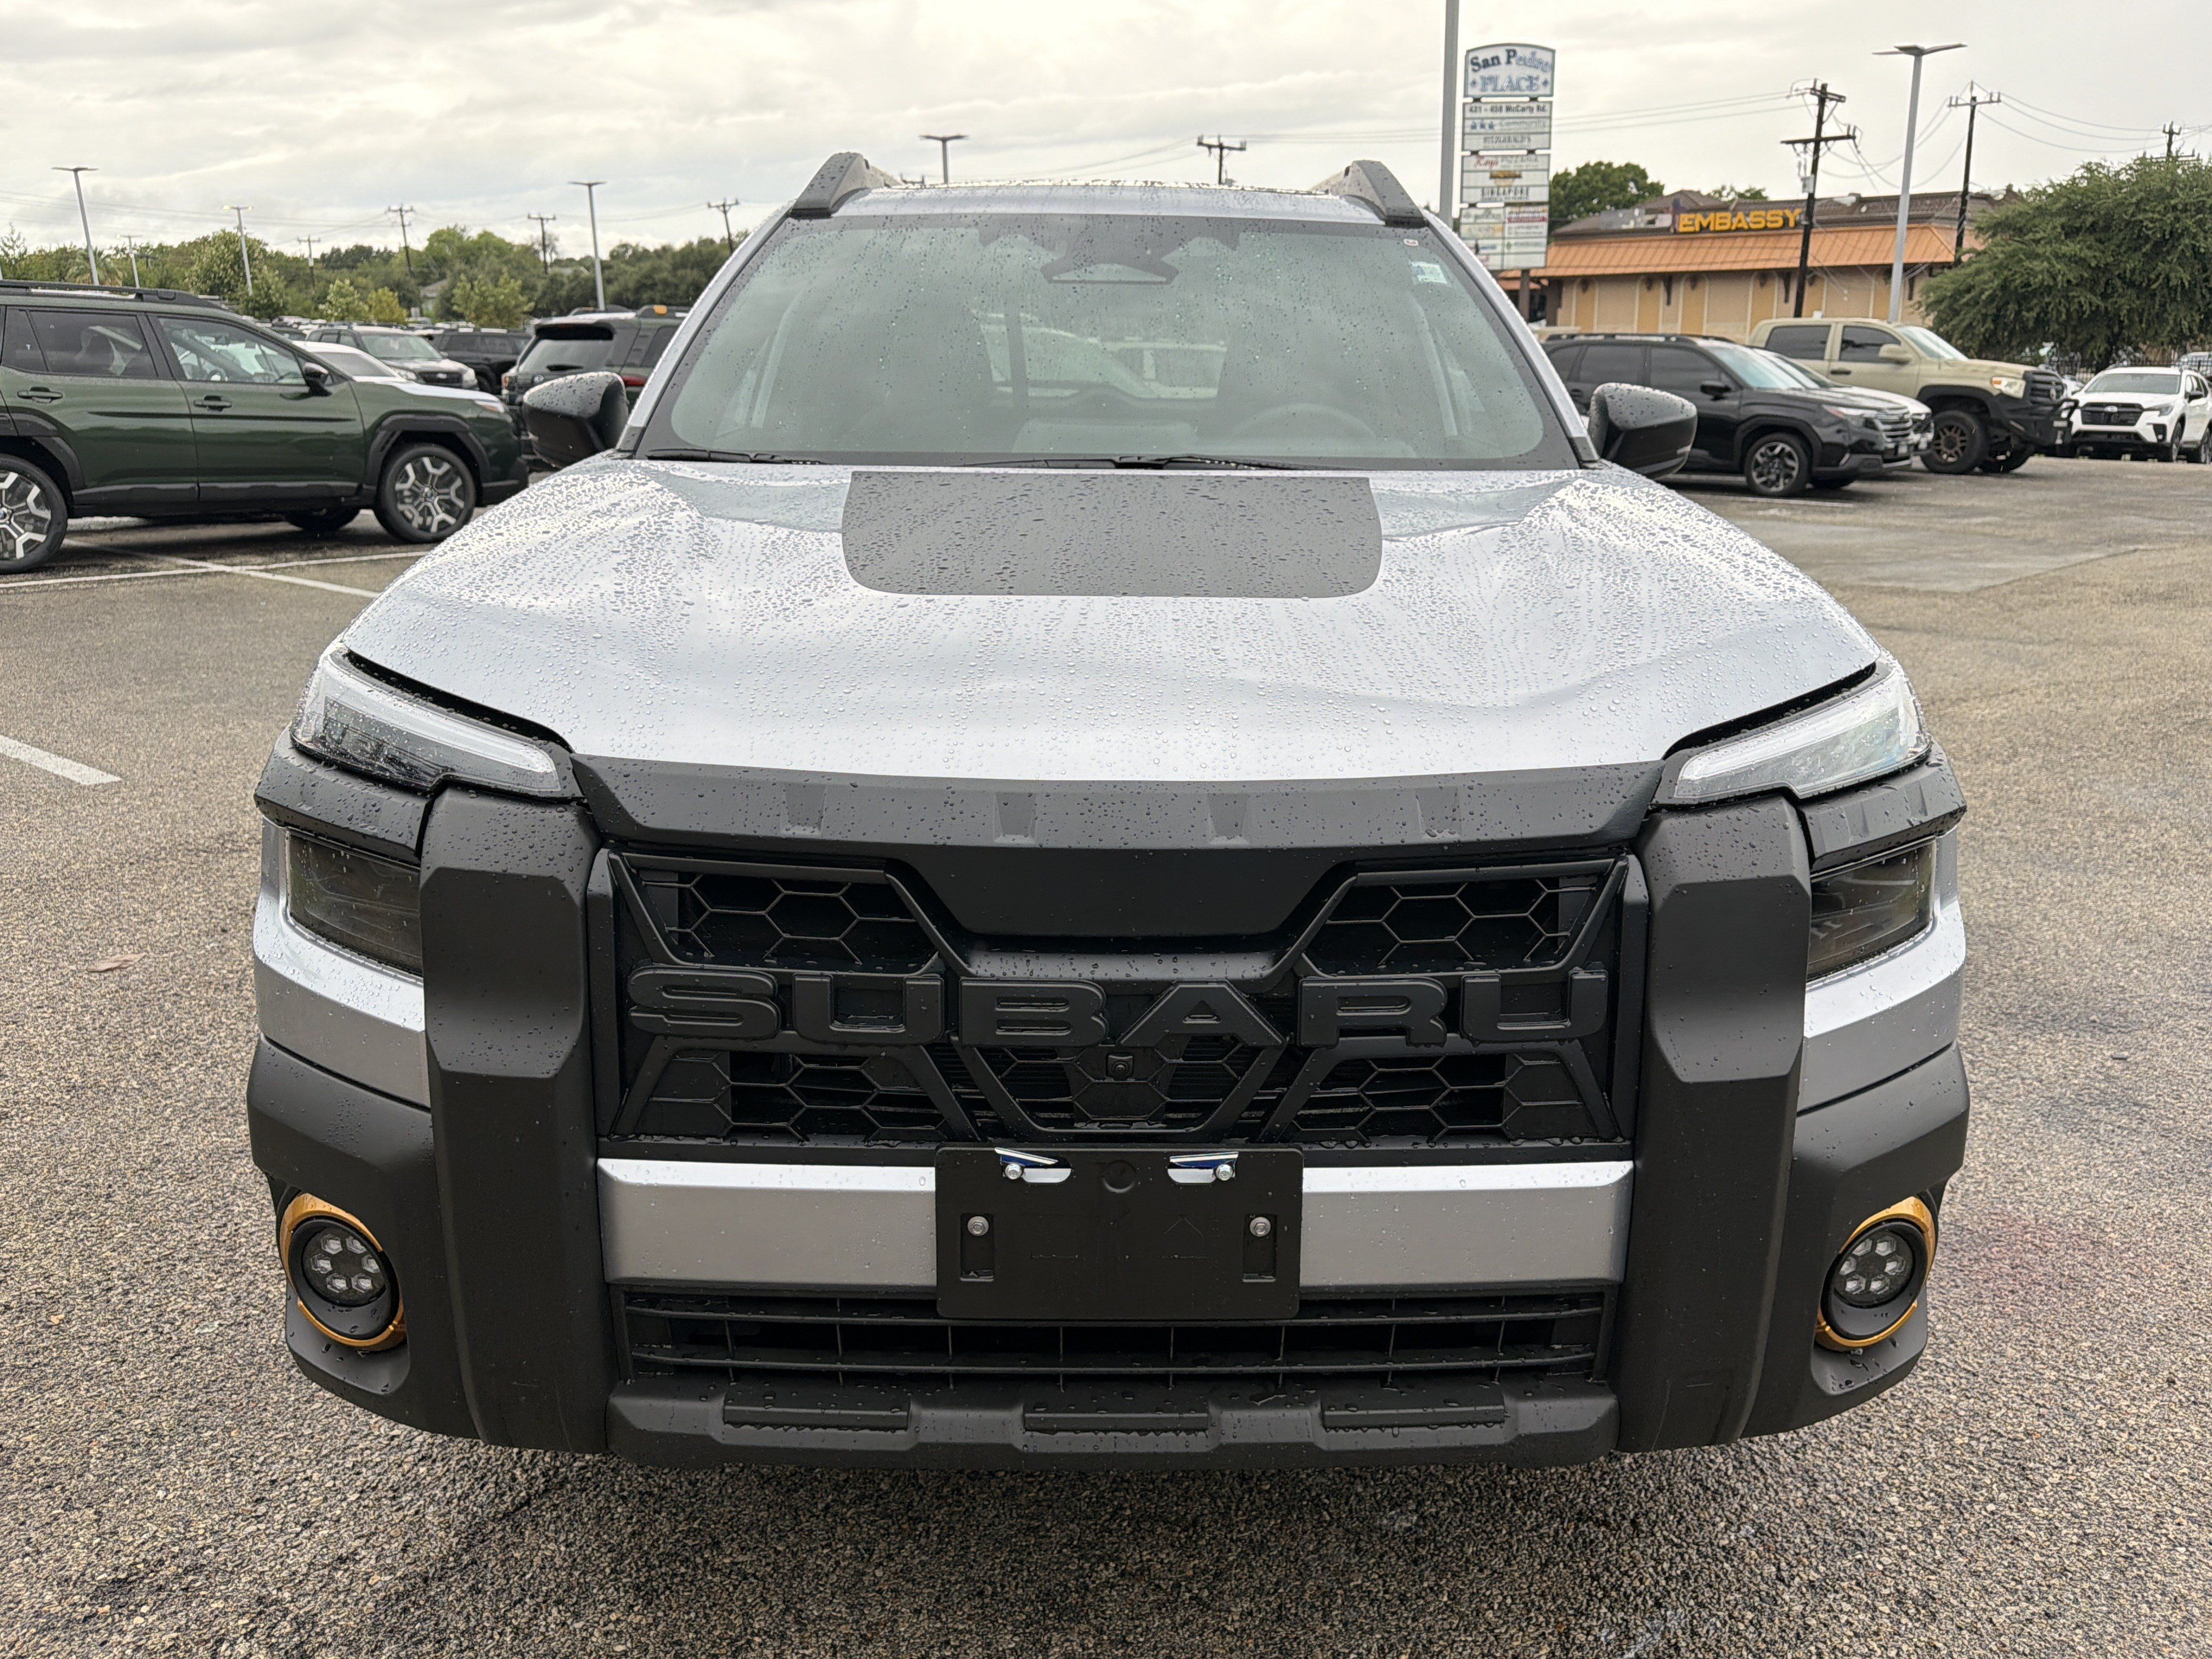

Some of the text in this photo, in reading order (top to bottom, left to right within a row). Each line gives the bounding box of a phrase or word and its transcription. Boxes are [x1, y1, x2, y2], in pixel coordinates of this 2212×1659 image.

[1470, 48, 1553, 73] San Pedro
[1480, 75, 1541, 92] PLACE
[1678, 208, 1802, 233] EMBASSY
[627, 964, 1609, 1048] SUBARU
